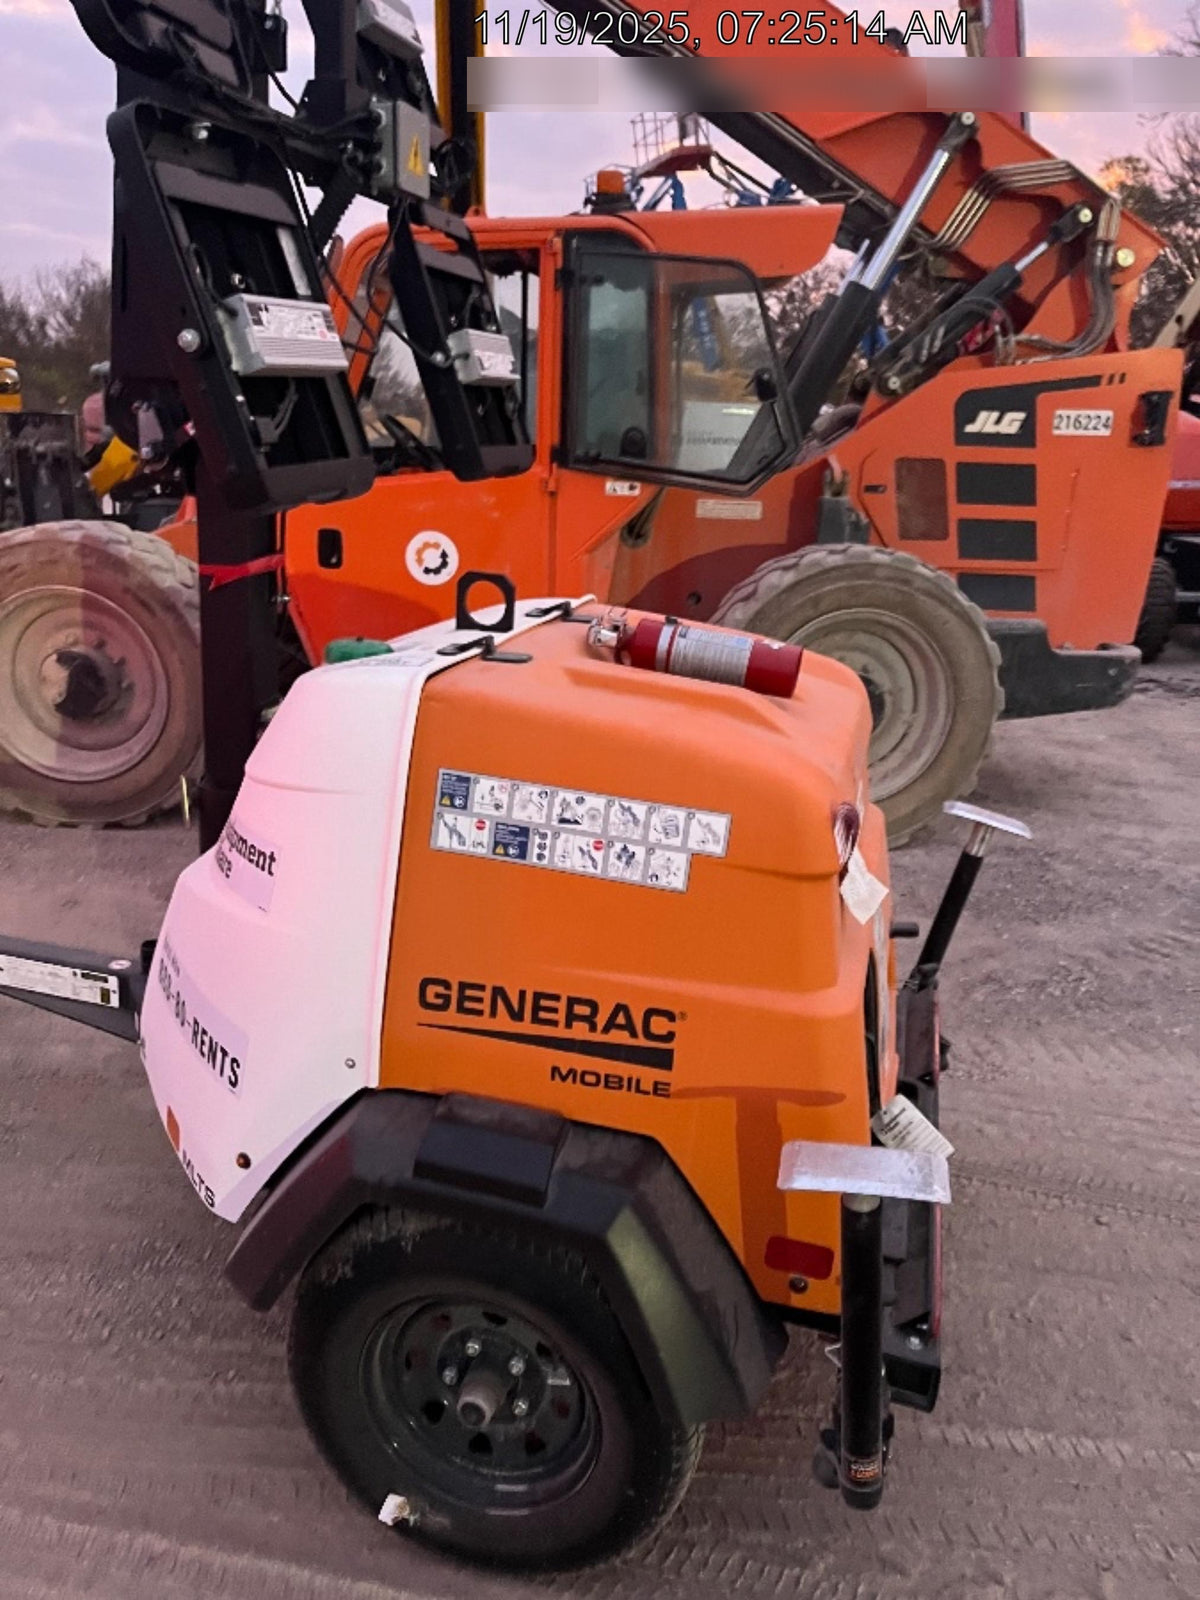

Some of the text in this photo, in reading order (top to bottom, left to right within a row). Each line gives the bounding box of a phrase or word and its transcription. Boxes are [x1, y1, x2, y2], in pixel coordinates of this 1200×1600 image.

[964, 410, 1027, 434] JLG
[1054, 414, 1111, 431] 216224
[418, 977, 677, 1044] GENERAC
[551, 1065, 672, 1098] MOBILE
